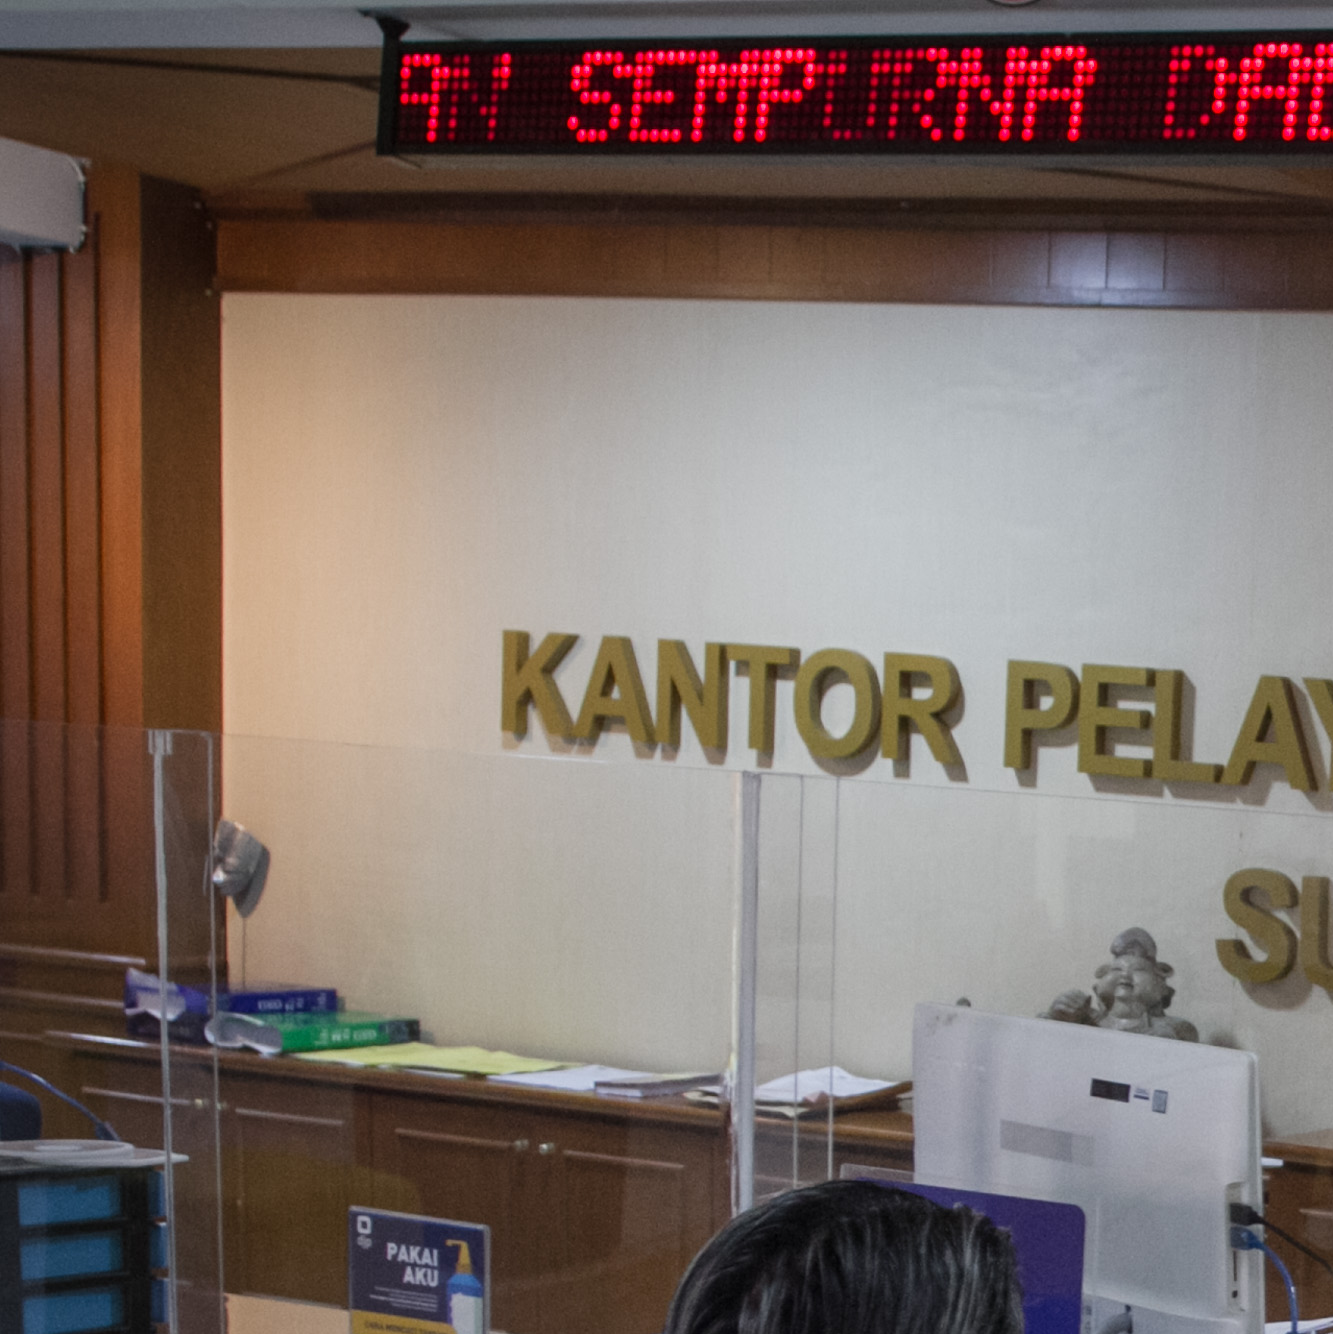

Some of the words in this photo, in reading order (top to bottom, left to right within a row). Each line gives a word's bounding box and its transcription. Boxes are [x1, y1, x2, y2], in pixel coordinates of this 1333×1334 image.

[567, 46, 1097, 142] SEMPURNA
[501, 629, 966, 768] KANTOR
[386, 1241, 439, 1267] PAKAI
[402, 1265, 439, 1288] AKU
